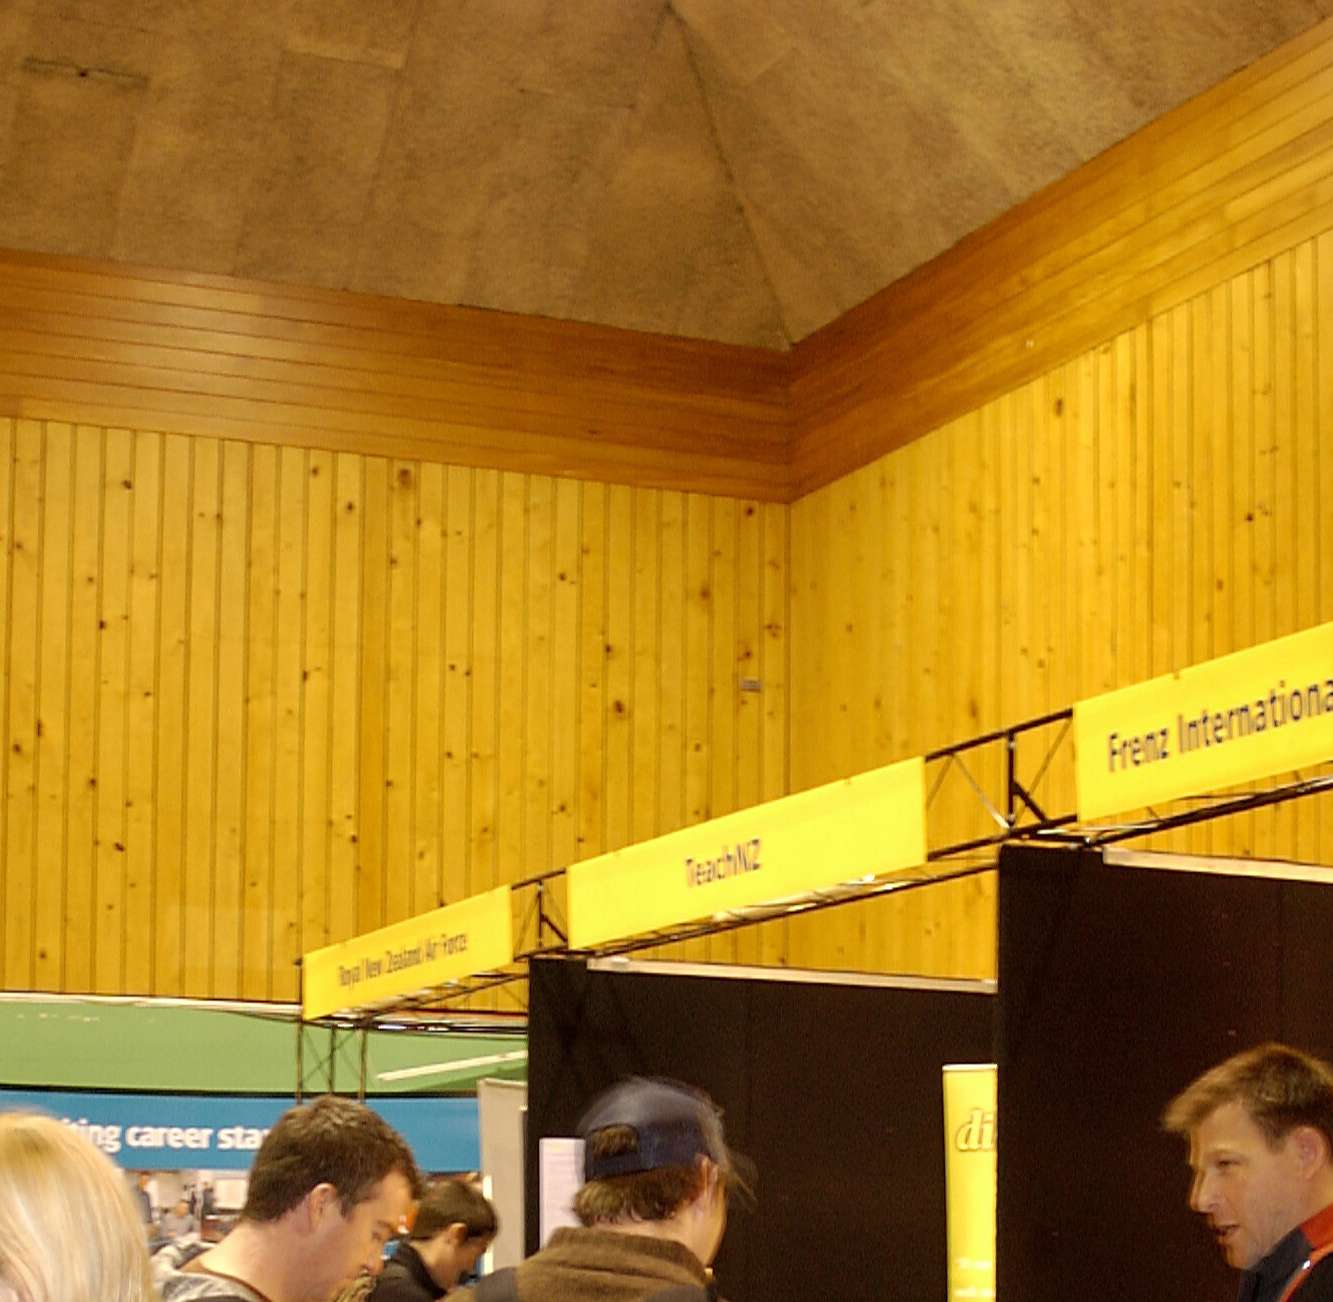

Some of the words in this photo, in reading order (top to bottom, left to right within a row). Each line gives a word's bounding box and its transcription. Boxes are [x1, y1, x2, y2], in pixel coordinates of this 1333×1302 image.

[1108, 729, 1170, 773] Frenz
[685, 838, 761, 889] TeachNZ
[124, 1125, 214, 1149] career
